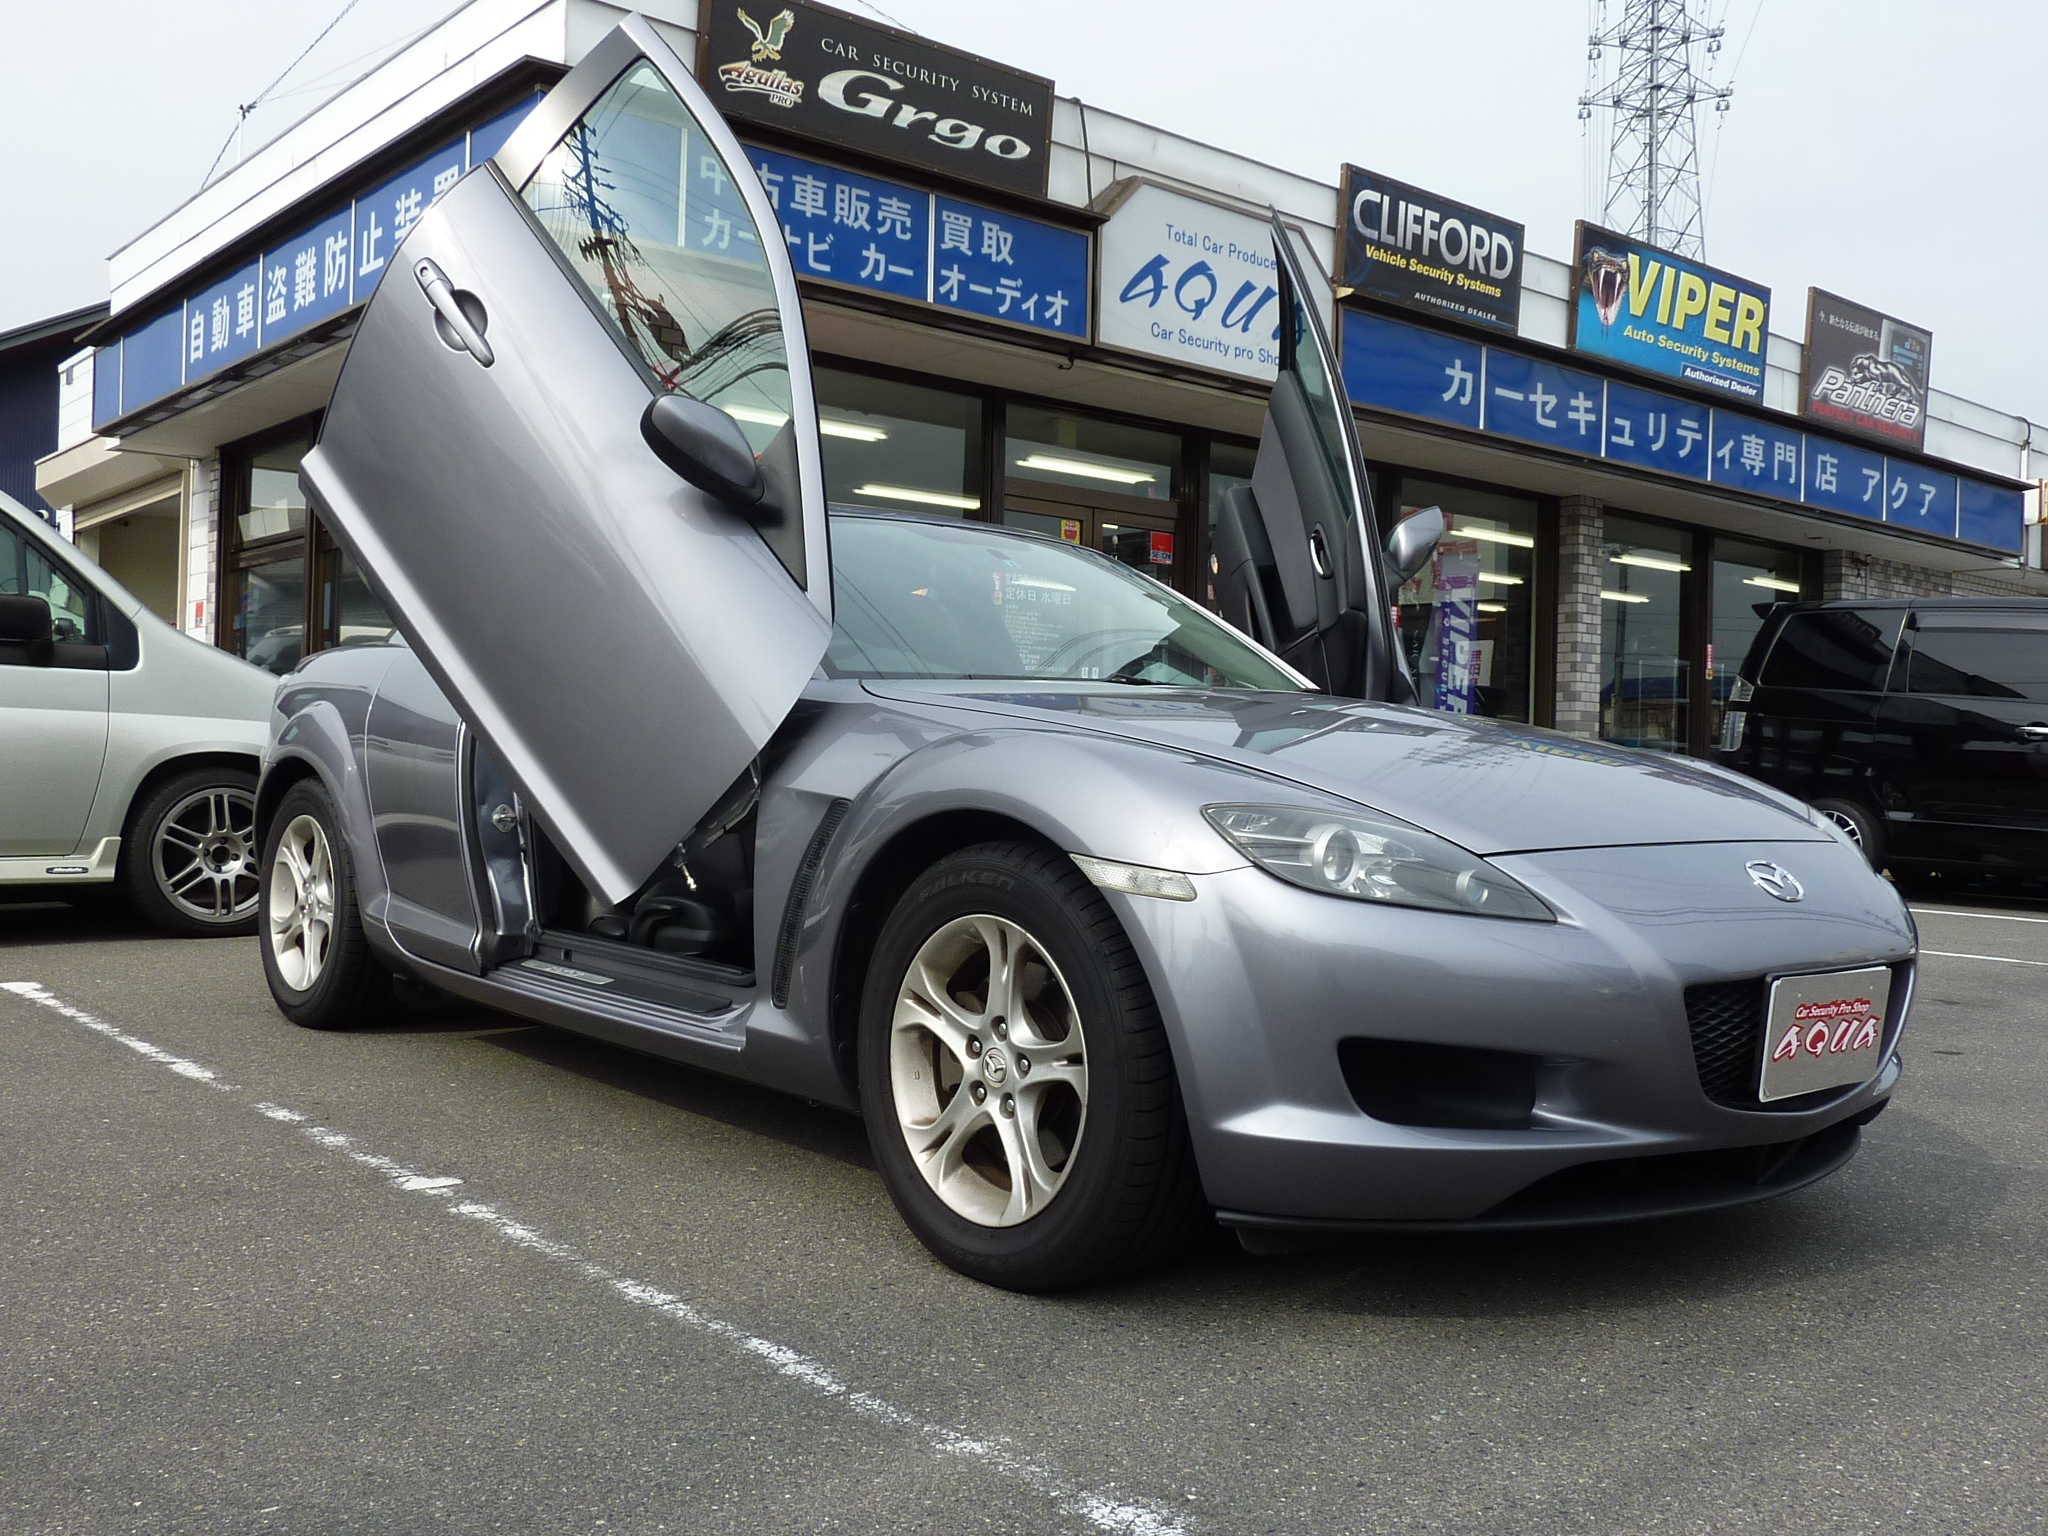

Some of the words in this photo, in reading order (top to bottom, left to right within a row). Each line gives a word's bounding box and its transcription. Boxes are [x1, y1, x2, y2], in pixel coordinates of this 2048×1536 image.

[770, 93, 794, 107] PRO
[821, 38, 859, 61] CAR
[872, 54, 961, 94] SECURITY
[971, 85, 1034, 117] SYSTEM
[817, 69, 1032, 161] Grgo
[1166, 223, 1198, 247] Total
[1202, 235, 1224, 255] Car
[1353, 189, 1514, 281] CLIFFORD
[1366, 244, 1408, 269] Vehicle
[1408, 258, 1455, 285] Security
[1457, 273, 1502, 298] Systems
[1413, 292, 1465, 312] AUTHORIZED
[1467, 307, 1497, 321] DEALER
[1628, 252, 1765, 355] VIPER
[1151, 322, 1174, 341] Car
[1178, 329, 1231, 357] Security
[1234, 345, 1254, 360] pro
[1258, 347, 1279, 367] Sho
[1623, 325, 1655, 344] Auto
[1657, 336, 1709, 362] Security
[1711, 352, 1761, 377] Systems
[1684, 367, 1730, 388] Authorized
[1730, 381, 1758, 397] Dealer
[1811, 401, 1855, 422] PERFECT
[1855, 413, 1875, 428] CAR
[1876, 421, 1919, 442] SECURITY
[1005, 587, 1037, 602] 定休日
[1040, 591, 1072, 606] 水曜日
[1796, 1005, 1810, 1018] Car
[1809, 1004, 1838, 1017] Security
[1838, 1003, 1852, 1014] Pro
[1852, 1001, 1870, 1015] Shop
[1774, 1016, 1879, 1061] AQUA
